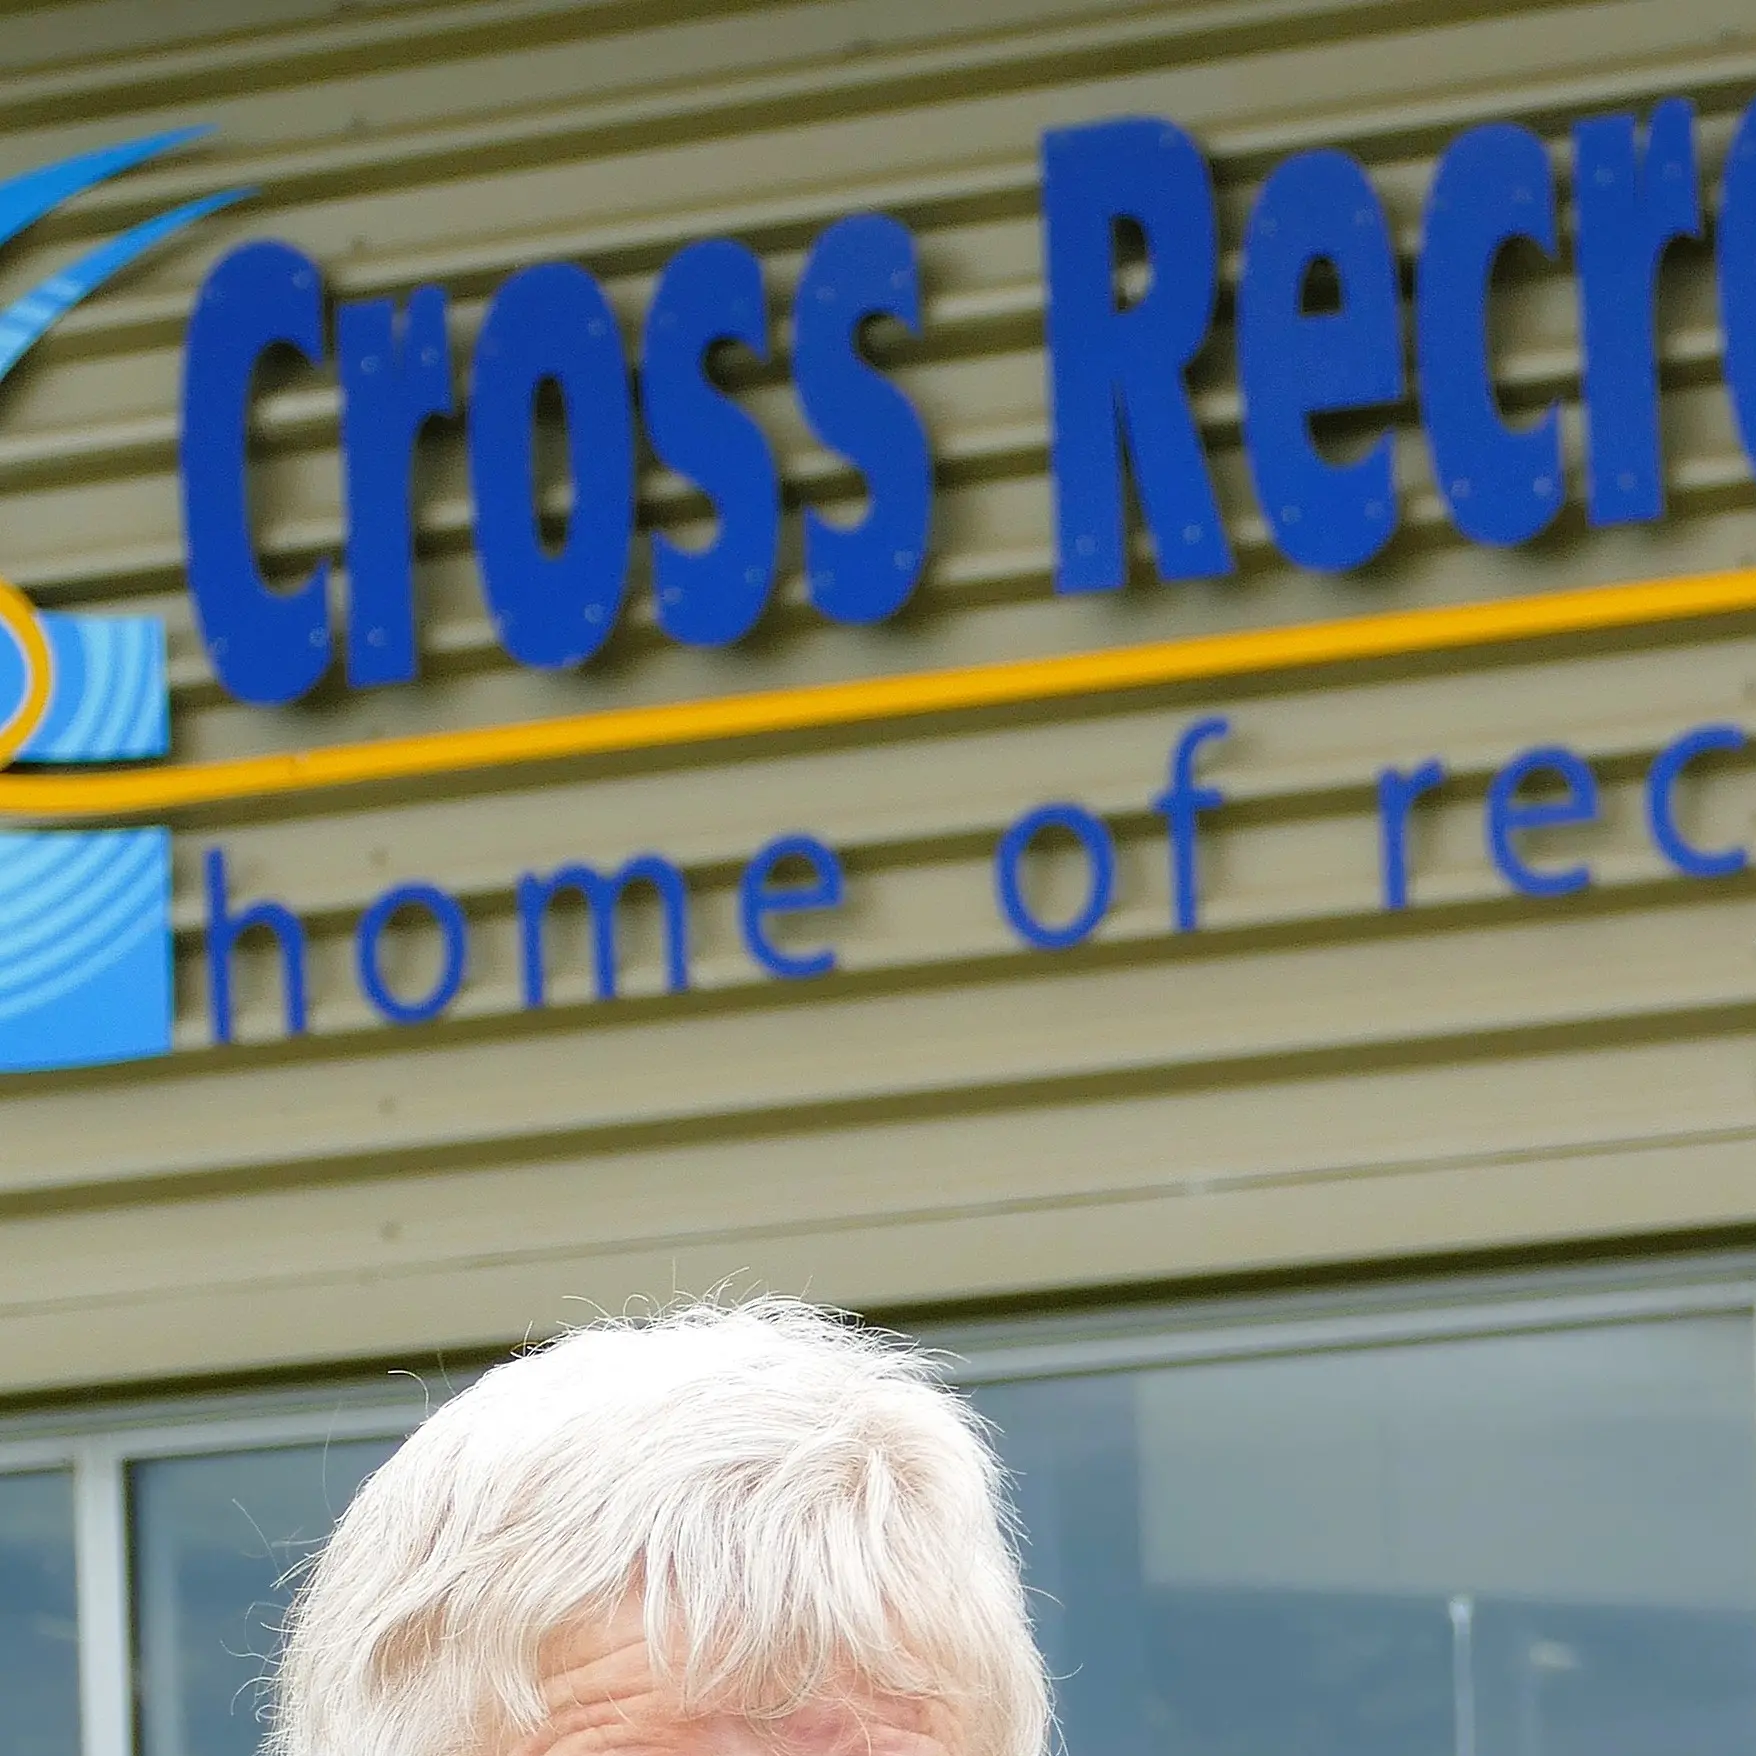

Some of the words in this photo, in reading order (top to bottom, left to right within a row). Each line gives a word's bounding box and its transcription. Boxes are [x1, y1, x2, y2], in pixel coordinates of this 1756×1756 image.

[178, 212, 933, 707] Cross
[203, 834, 846, 1045] home
[994, 716, 1230, 950] of
